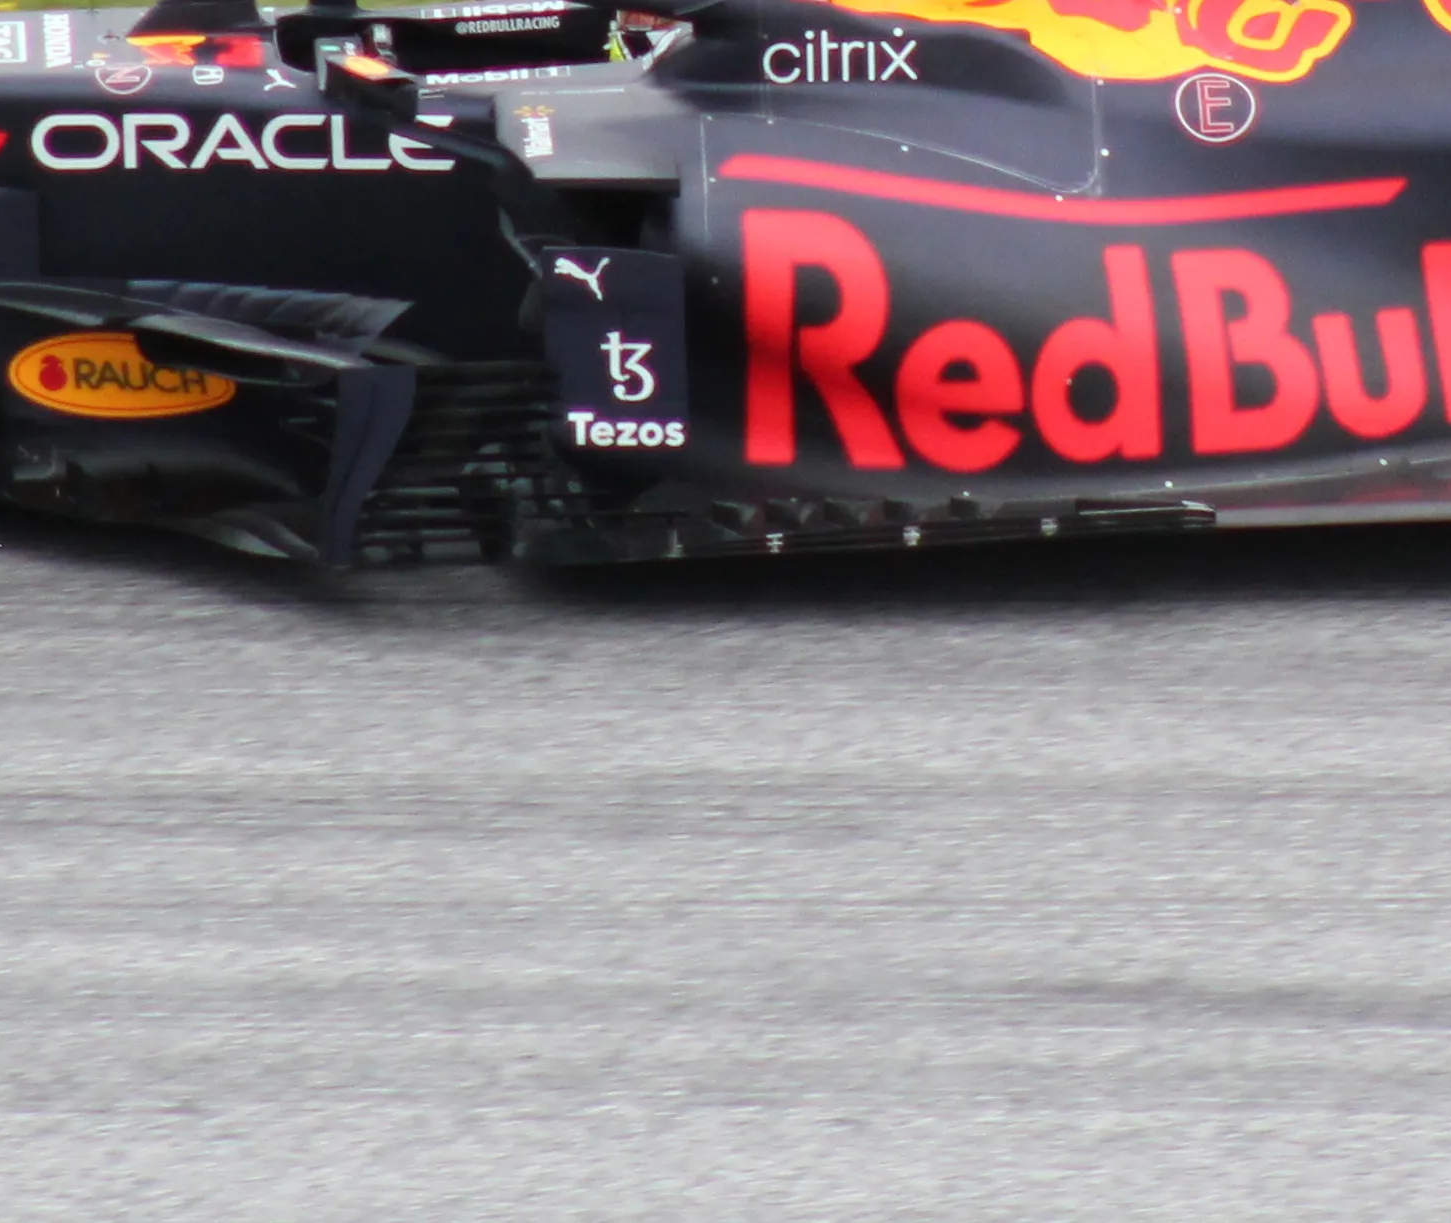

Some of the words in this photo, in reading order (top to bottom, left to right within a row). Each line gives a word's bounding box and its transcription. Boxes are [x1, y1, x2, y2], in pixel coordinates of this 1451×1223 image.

[455, 16, 561, 36] @REDBULLRACING
[762, 26, 919, 84] citrix
[425, 68, 529, 86] Mobil
[31, 113, 456, 171] ORACLE
[72, 357, 210, 395] RAUCH
[567, 412, 686, 447] Tezos
